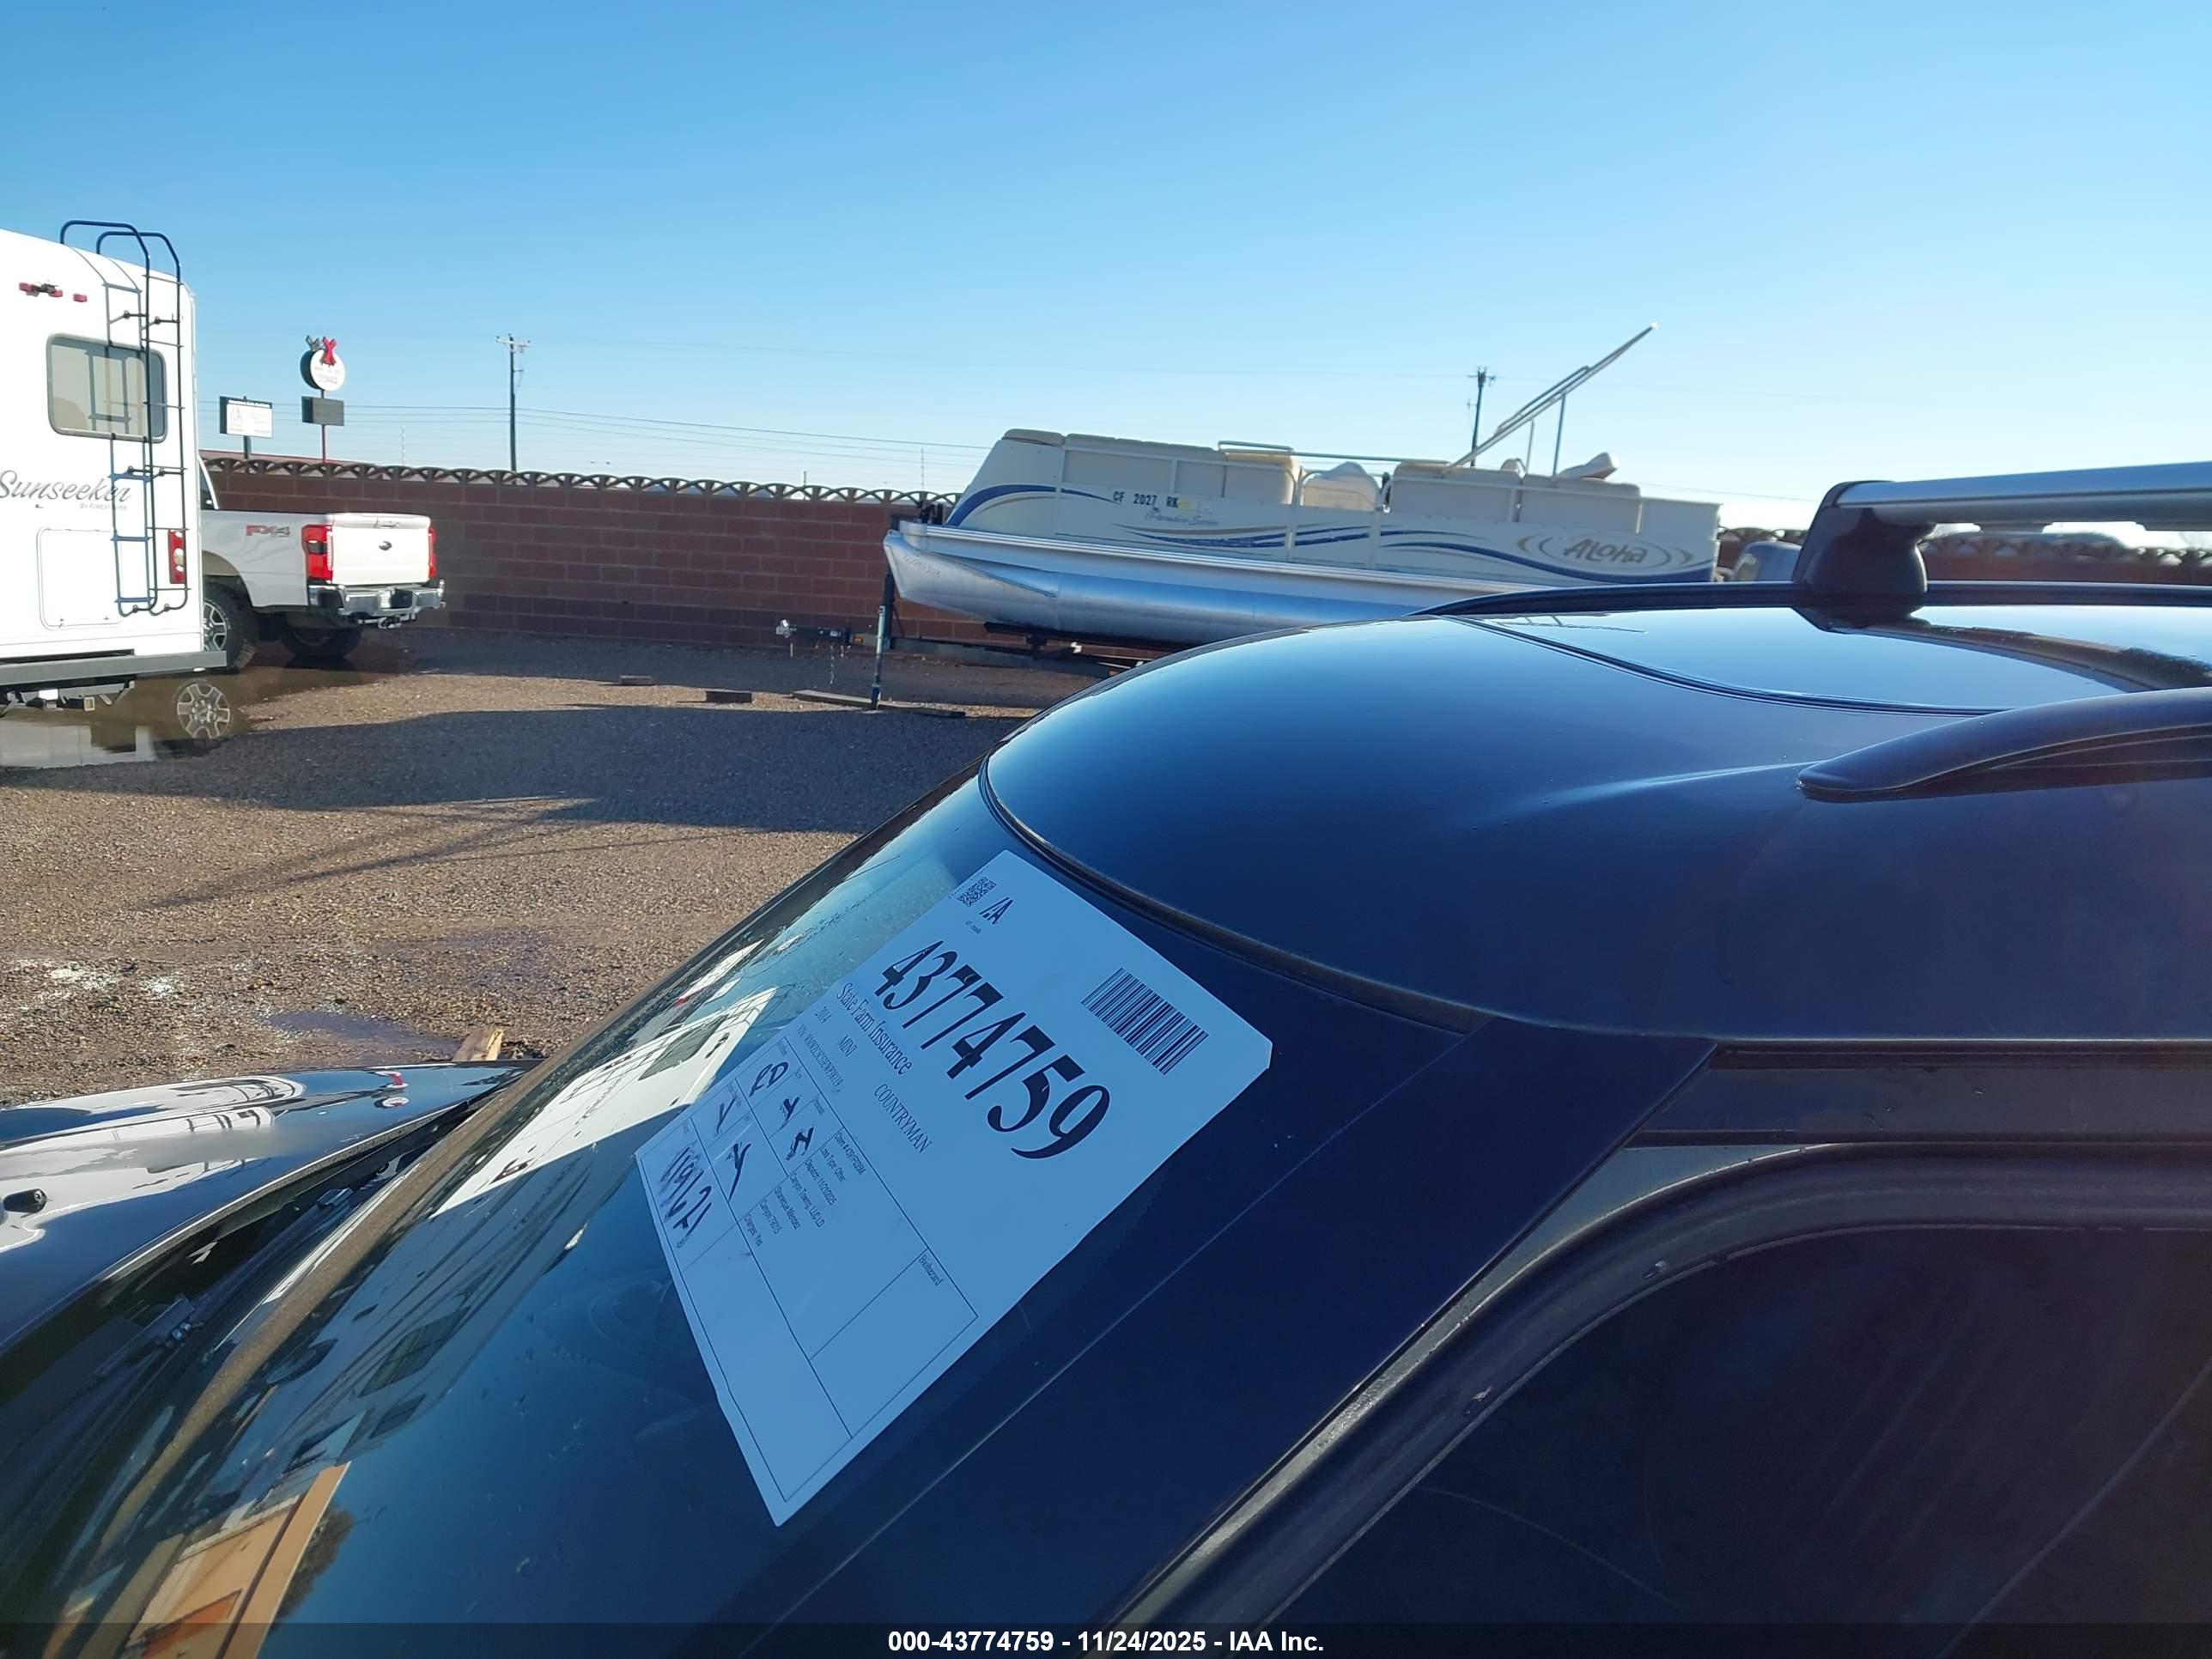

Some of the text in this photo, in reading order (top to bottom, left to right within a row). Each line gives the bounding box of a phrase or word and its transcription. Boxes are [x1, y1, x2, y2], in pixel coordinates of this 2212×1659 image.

[0, 470, 131, 502] Sunseeker
[1113, 491, 1179, 508] CF 2027 RK
[246, 525, 290, 538] FX4
[836, 982, 912, 1075] State Farm Insurance
[874, 940, 1110, 1159] 43774759
[814, 1006, 932, 1152] 2014 MINI COUNTRYMAN
[834, 1132, 846, 1148] Claim
[819, 1146, 830, 1158] Loss
[834, 1167, 847, 1182] Other
[789, 1172, 803, 1192] Canyon
[809, 1206, 821, 1220] LLC
[815, 1216, 825, 1228] LD
[754, 1234, 763, 1248] Yes
[918, 1254, 944, 1286] Biohazard
